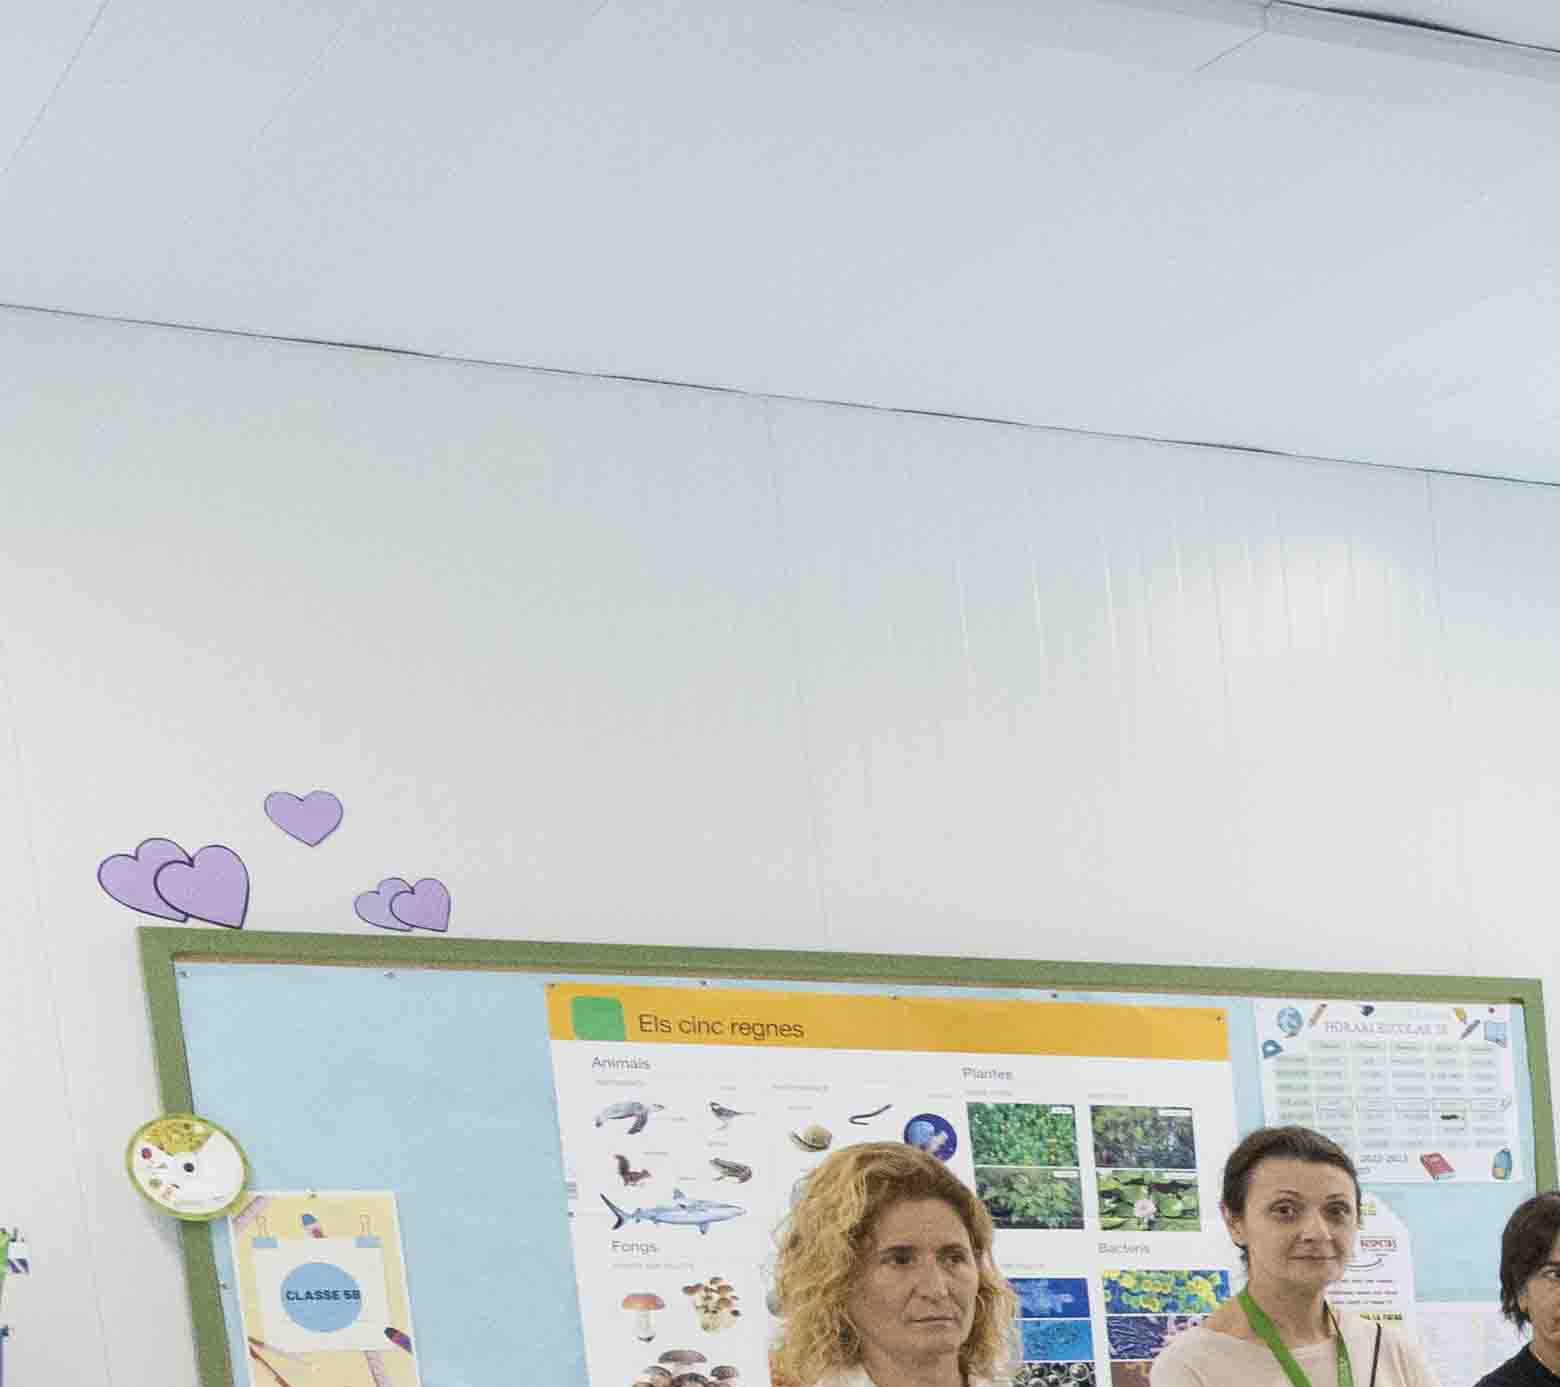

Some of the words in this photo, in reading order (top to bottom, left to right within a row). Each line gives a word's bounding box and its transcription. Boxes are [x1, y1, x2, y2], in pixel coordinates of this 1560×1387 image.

[638, 1013, 672, 1034] Els
[678, 1016, 723, 1036] cinc
[730, 1019, 805, 1041] regnes
[591, 1055, 651, 1070] Animals
[962, 1066, 1014, 1081] Plantes
[611, 1239, 657, 1257] Fongs
[285, 1289, 341, 1301] CLASSE
[343, 1290, 361, 1300] 5B
